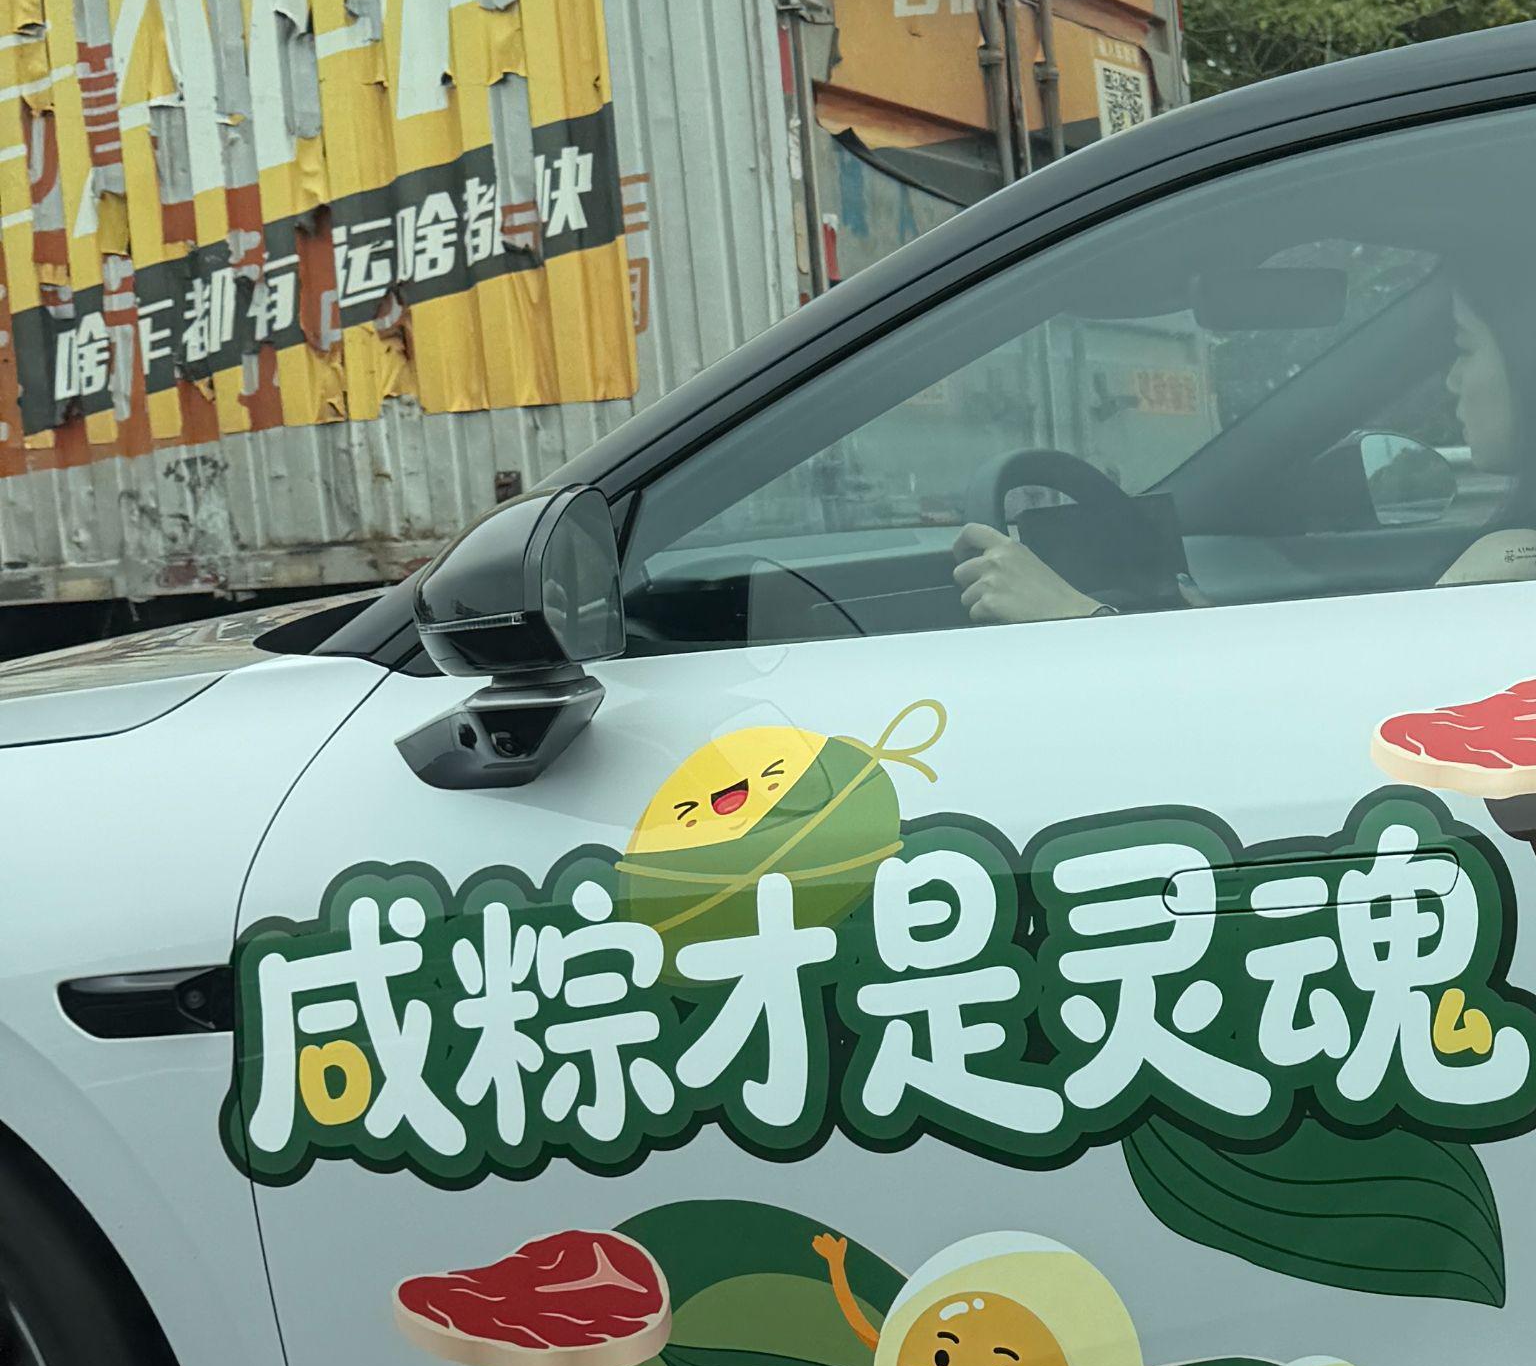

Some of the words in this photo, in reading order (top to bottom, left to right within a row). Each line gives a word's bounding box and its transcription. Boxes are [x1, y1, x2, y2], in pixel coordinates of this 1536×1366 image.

[248, 822, 1531, 1157] 咸粽才是灵魂
